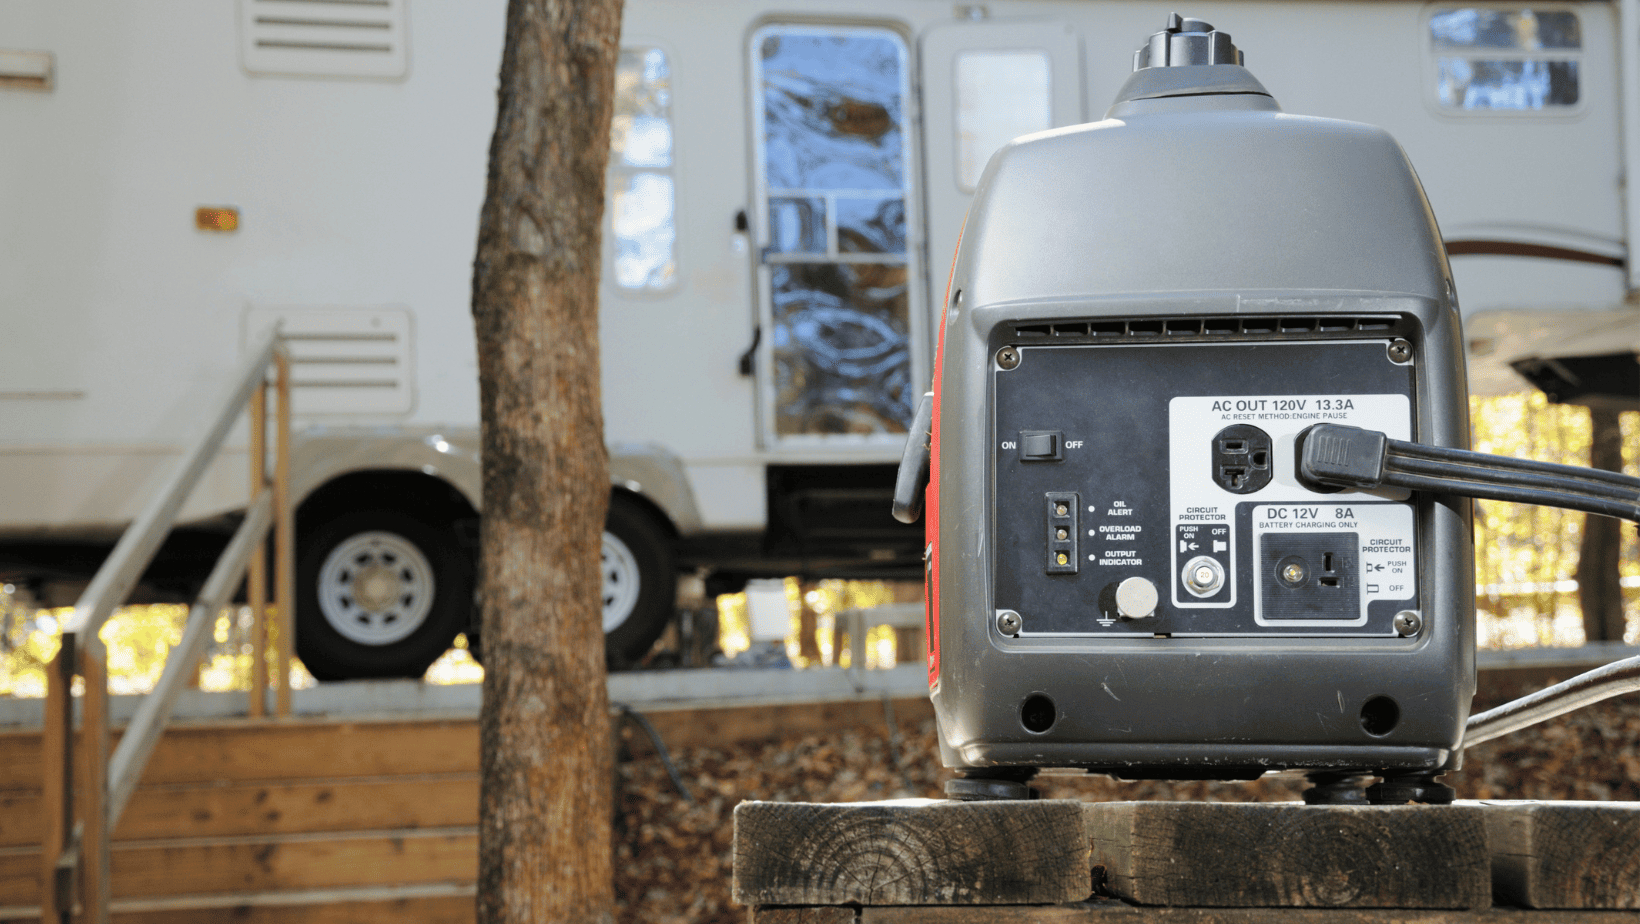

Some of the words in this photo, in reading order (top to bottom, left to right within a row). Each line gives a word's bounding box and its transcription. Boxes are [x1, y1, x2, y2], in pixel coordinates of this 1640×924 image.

[1212, 401, 1232, 412] AC
[1236, 400, 1267, 411] OUT
[1272, 400, 1306, 411] 120V
[1316, 399, 1354, 410] 13.3A
[1066, 441, 1083, 449] OFF
[1268, 508, 1287, 519] DC
[1293, 508, 1318, 519] 12V
[1335, 508, 1354, 518] 8A
